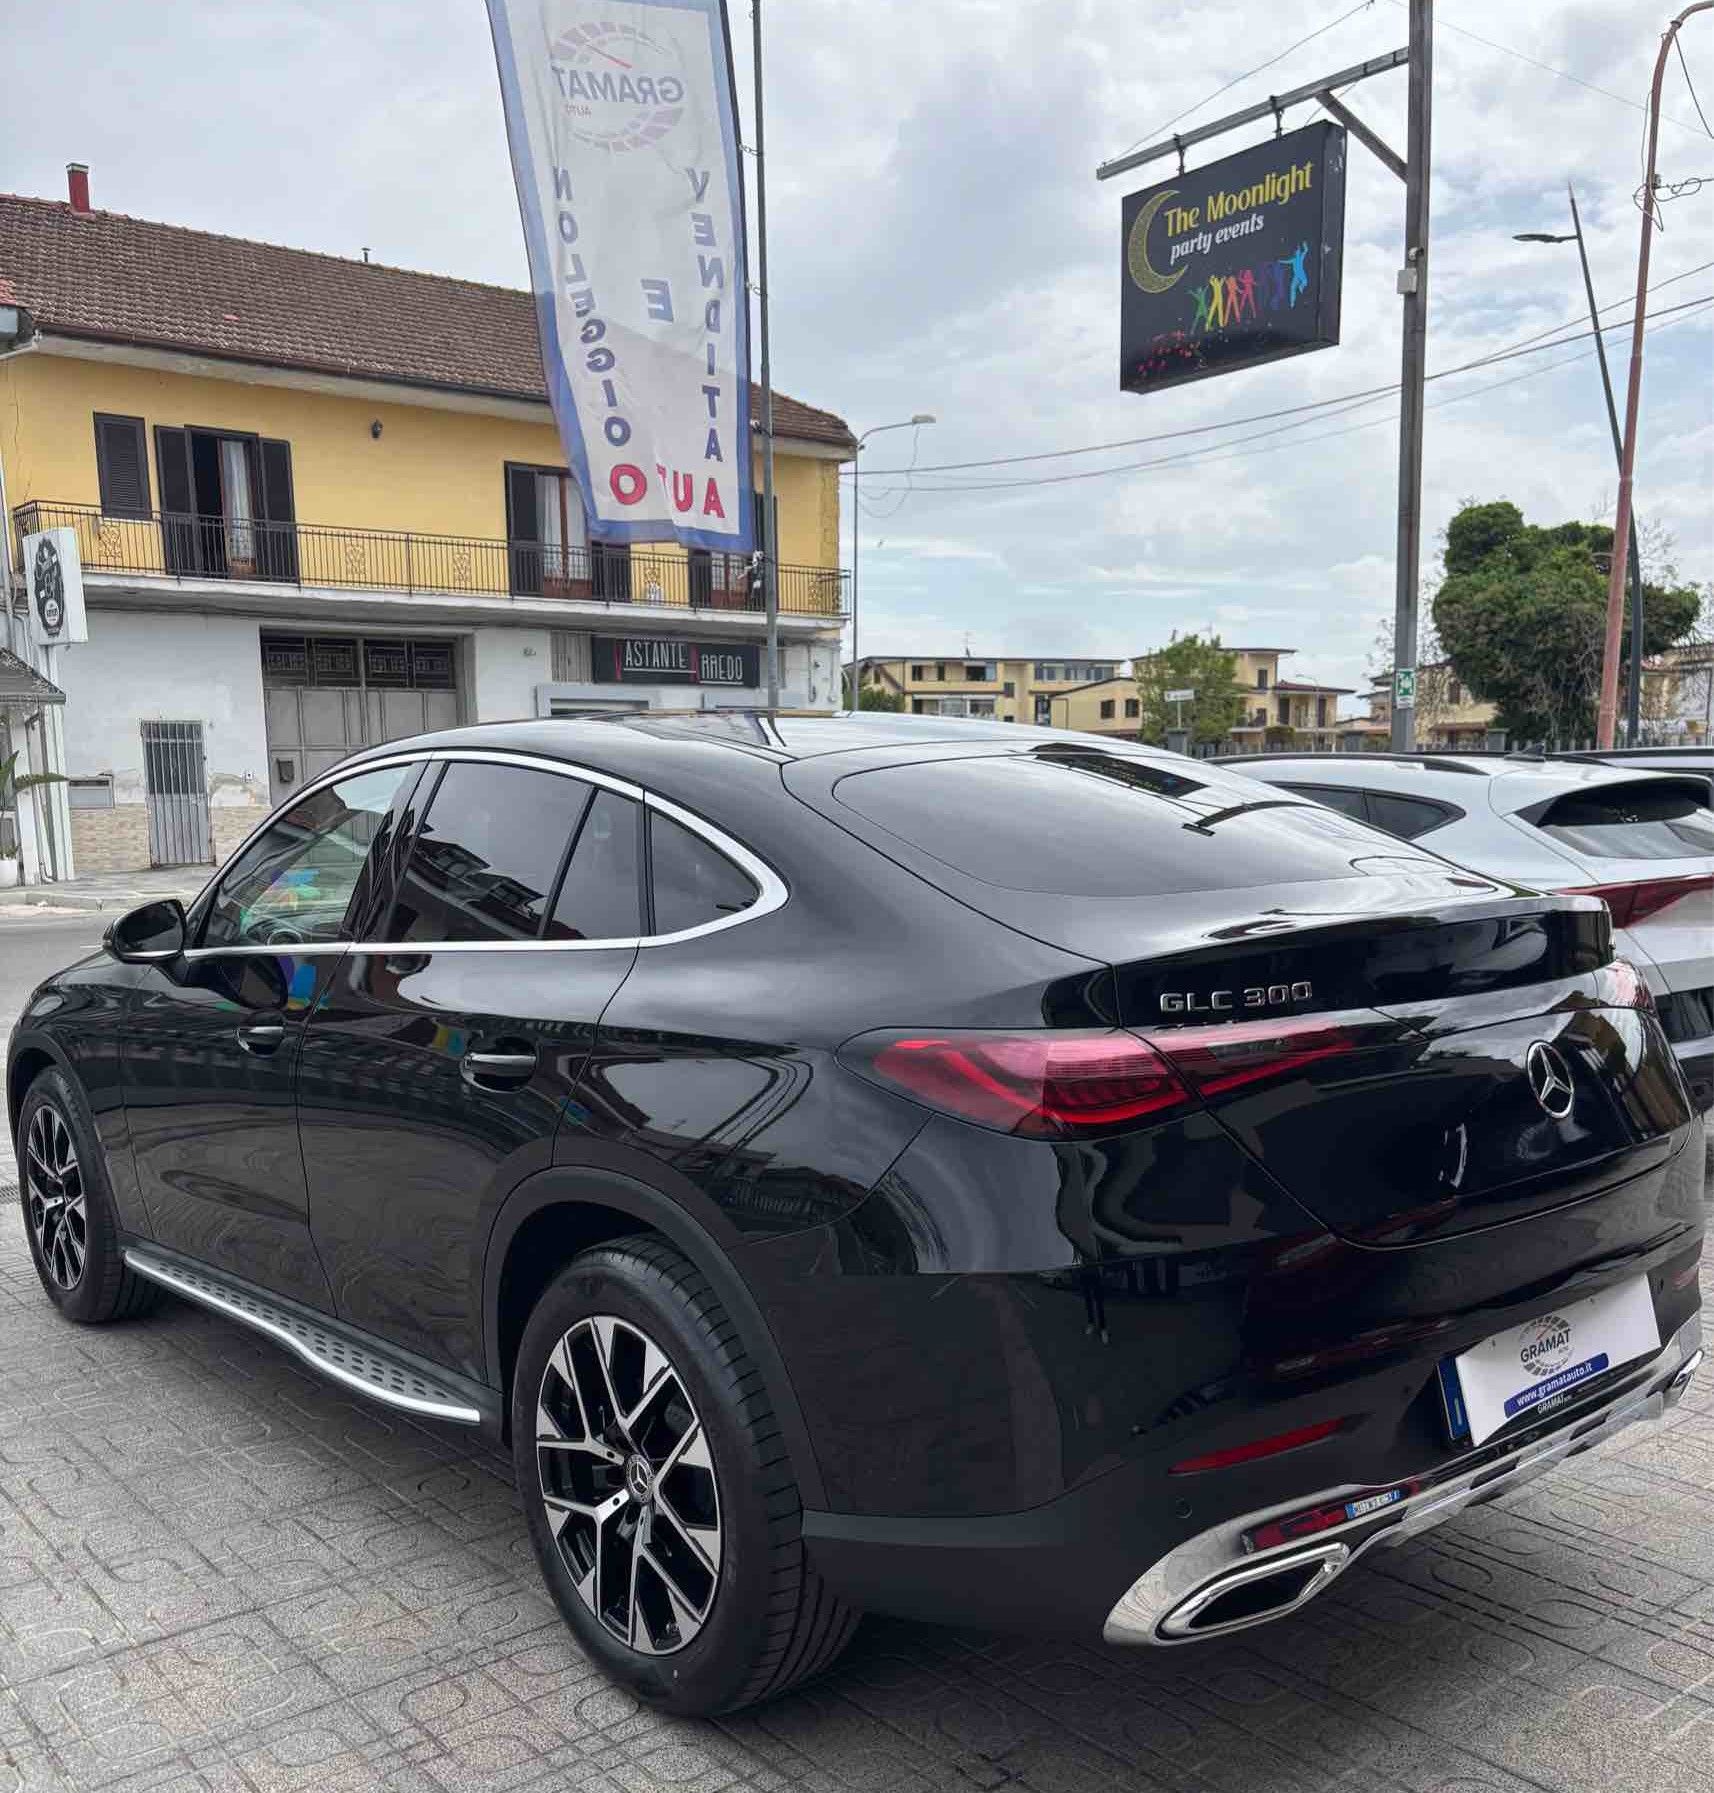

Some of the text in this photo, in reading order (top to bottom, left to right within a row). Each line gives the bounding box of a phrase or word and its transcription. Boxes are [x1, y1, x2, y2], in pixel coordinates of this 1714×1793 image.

[1163, 160, 1314, 237] The Moonlight
[1169, 213, 1265, 265] party events
[1160, 981, 1313, 1014] GLC 300
[1520, 1328, 1571, 1363] GRAMAT
[1517, 1361, 1593, 1407] www.gramatauto.it
[1537, 1393, 1565, 1415] GRAMAT
